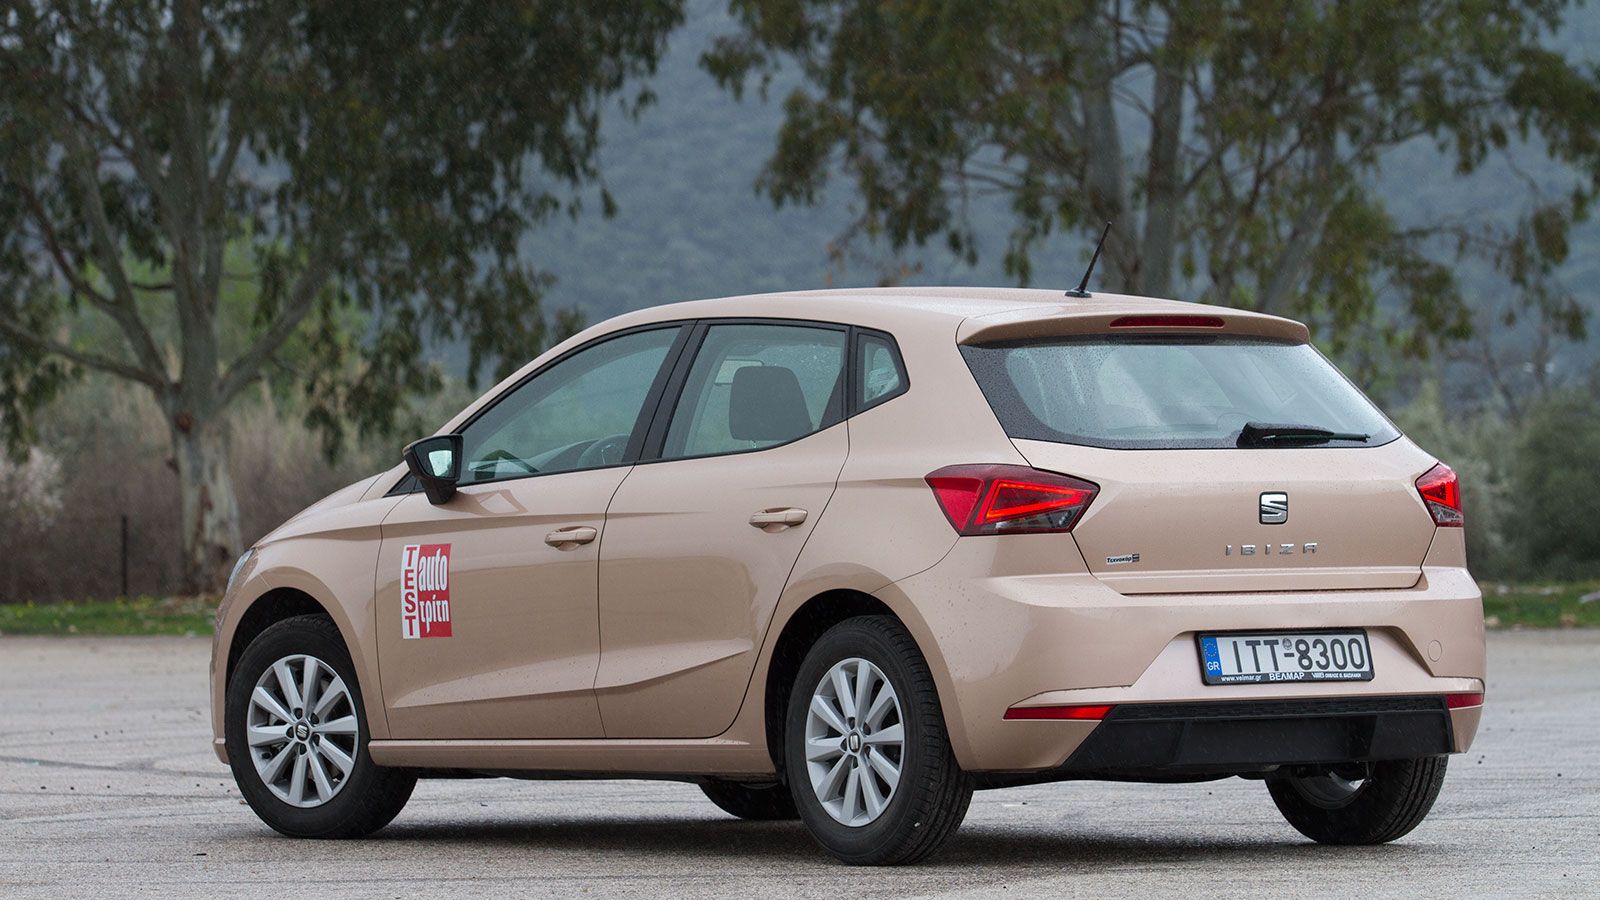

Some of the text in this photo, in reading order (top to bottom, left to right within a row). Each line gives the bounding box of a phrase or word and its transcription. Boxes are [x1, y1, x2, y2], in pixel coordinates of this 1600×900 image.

[1225, 543, 1317, 556] IBIZA
[419, 548, 448, 591] auto
[404, 546, 418, 636] TEST
[1207, 661, 1220, 671] GR
[1232, 638, 1365, 673] ITT-8300
[1221, 674, 1262, 682] www.velmar.gr
